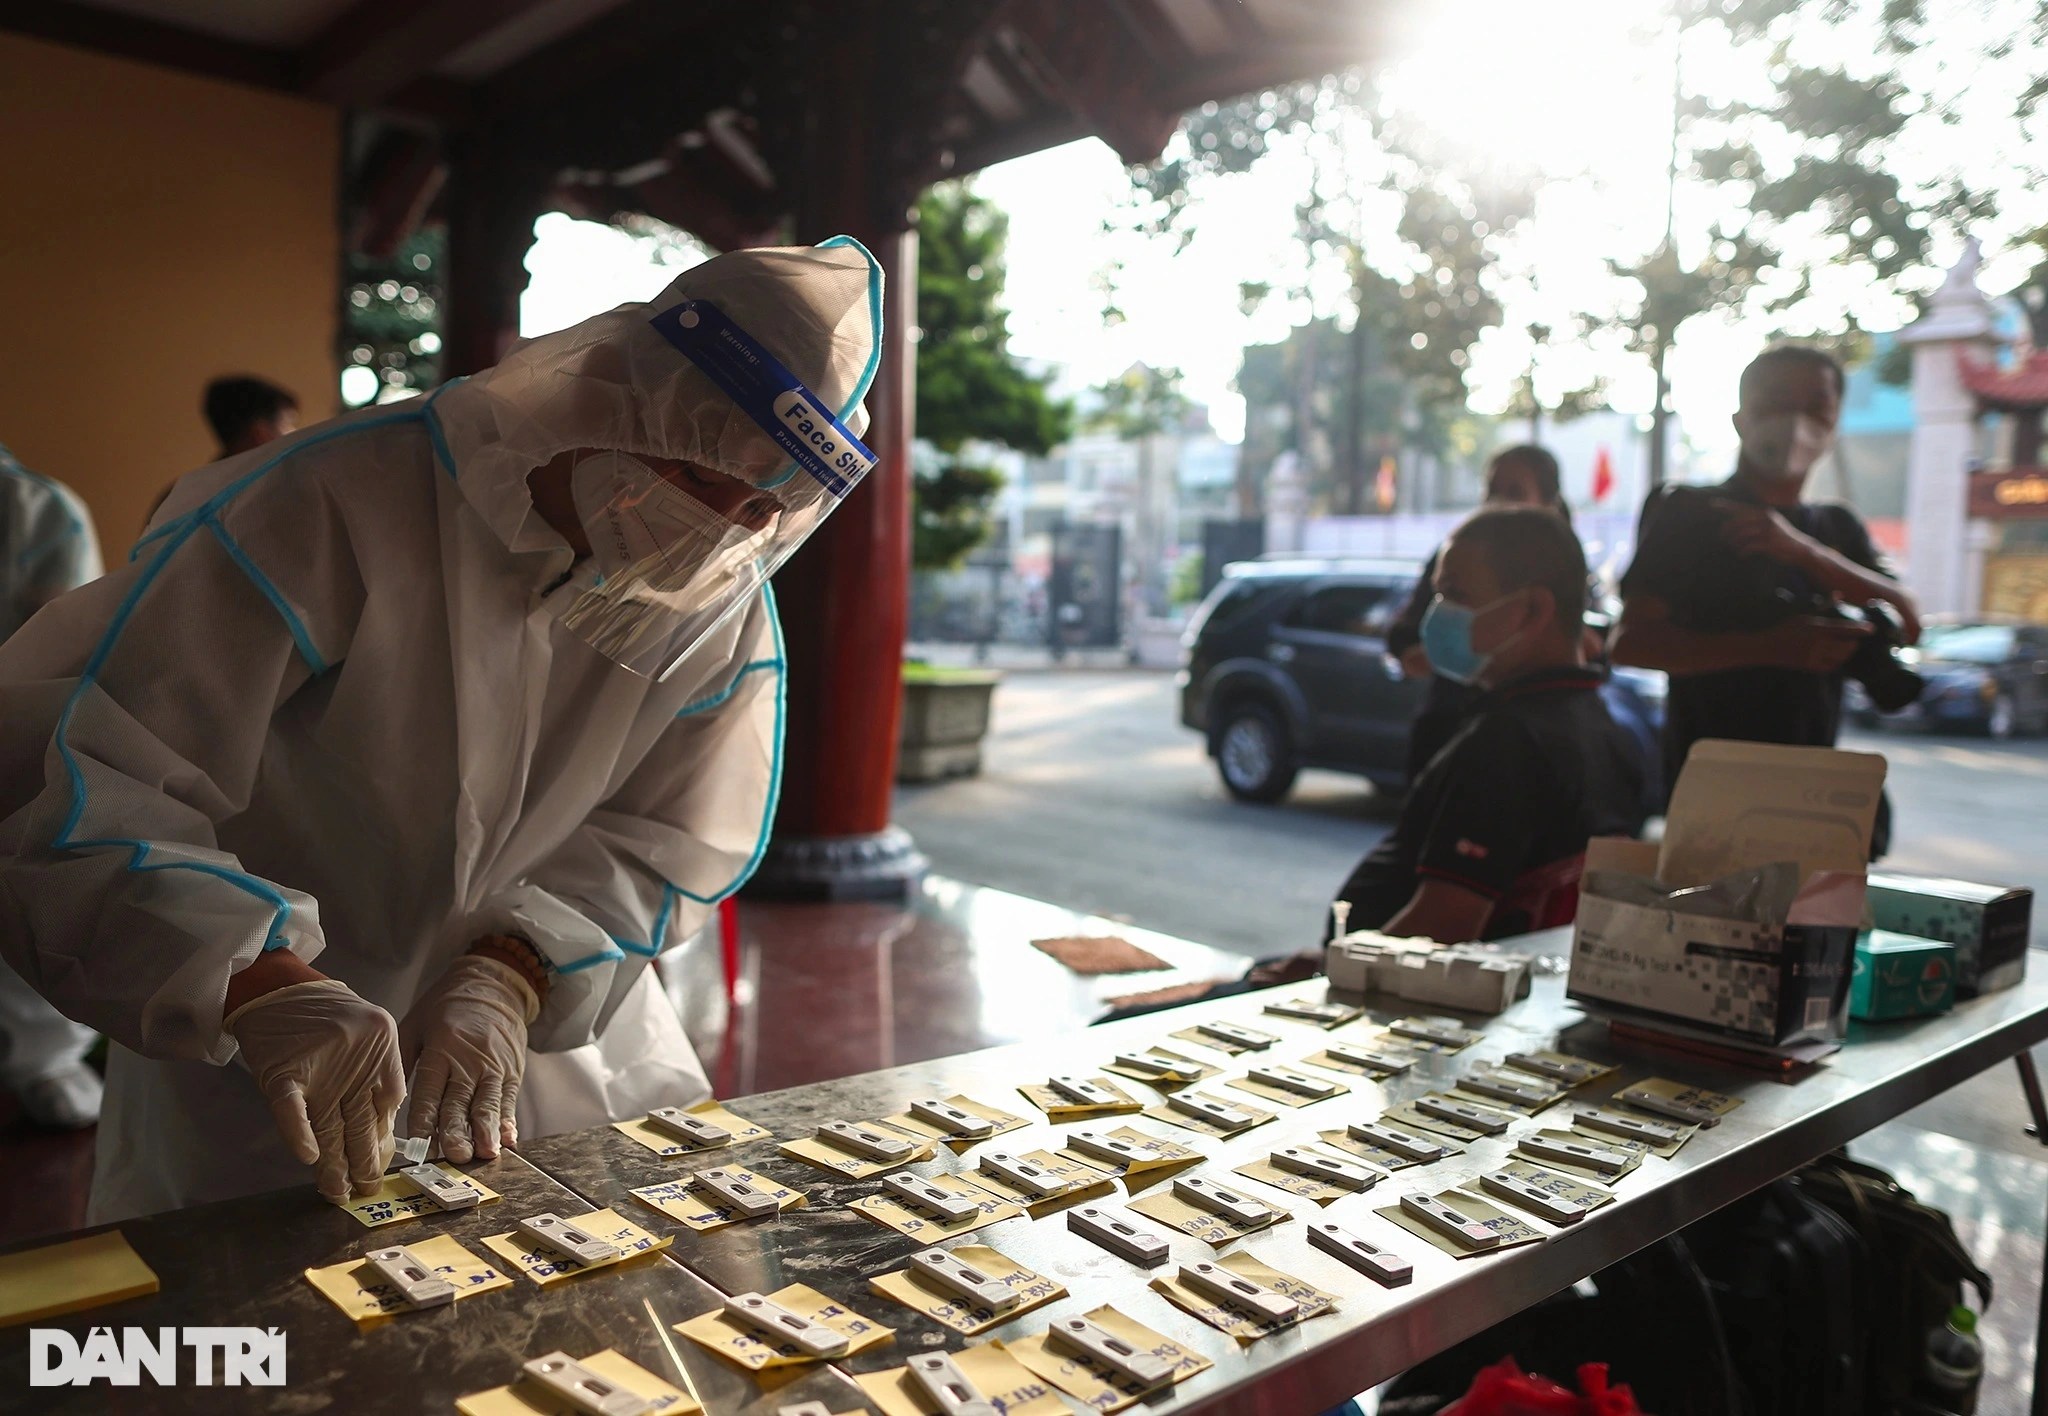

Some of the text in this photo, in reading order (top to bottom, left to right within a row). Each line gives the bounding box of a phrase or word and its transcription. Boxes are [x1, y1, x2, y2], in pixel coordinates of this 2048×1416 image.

[720, 328, 761, 366] Warning:
[785, 402, 836, 455] Face
[776, 430, 818, 472] Protective
